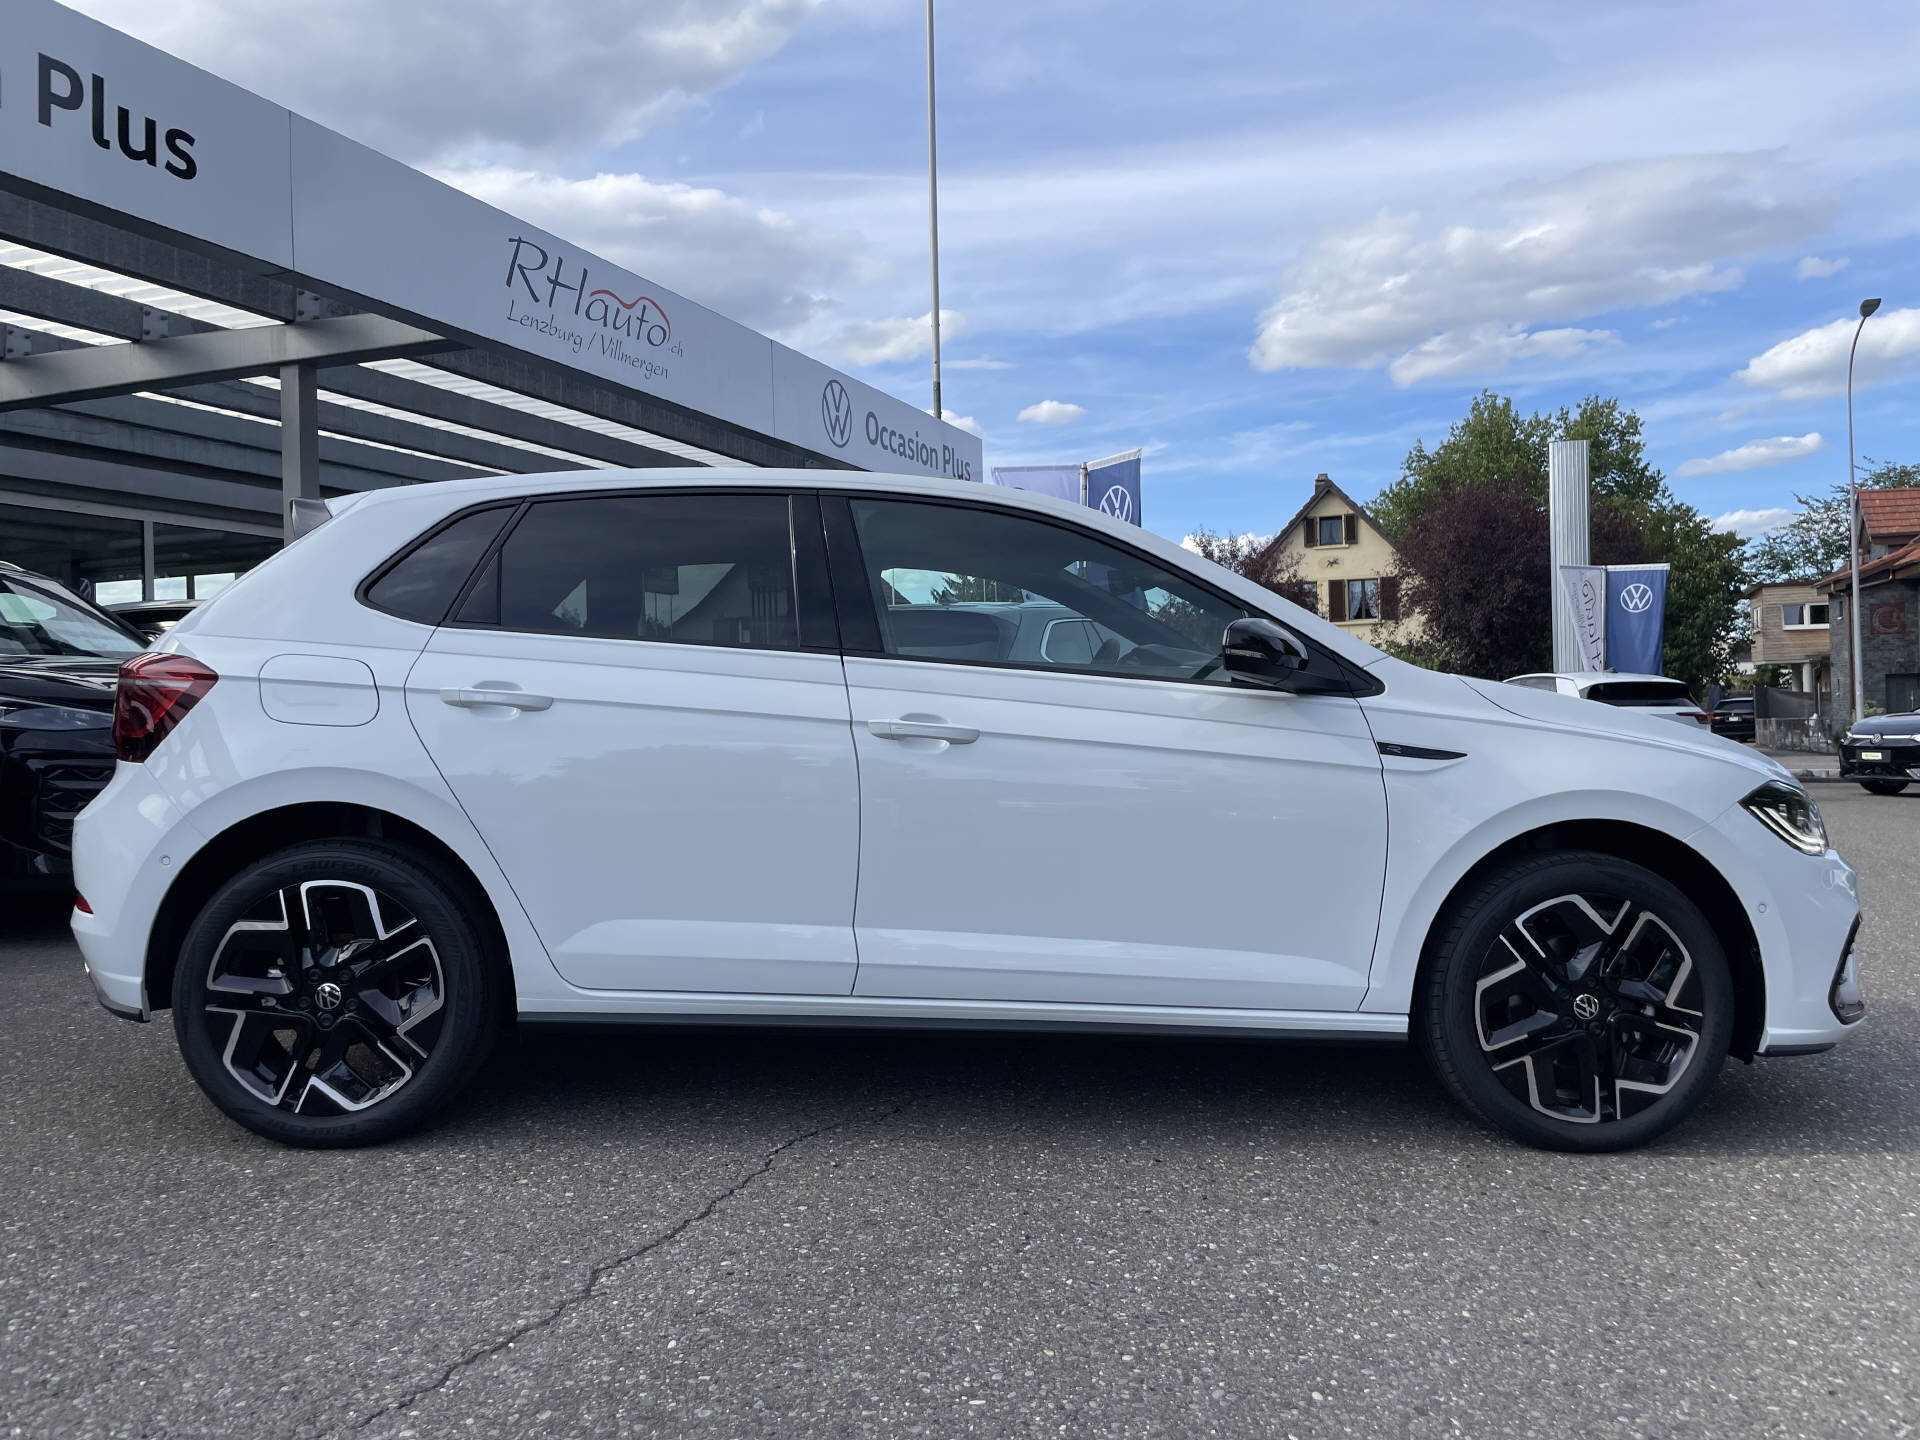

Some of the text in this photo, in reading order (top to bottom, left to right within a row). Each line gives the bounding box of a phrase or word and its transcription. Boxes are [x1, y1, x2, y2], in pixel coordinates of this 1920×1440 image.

[38, 52, 197, 180] Plus
[507, 299, 583, 354] Lenzburg
[601, 334, 669, 380] Villmergen
[866, 411, 971, 481] Occasion Plus
